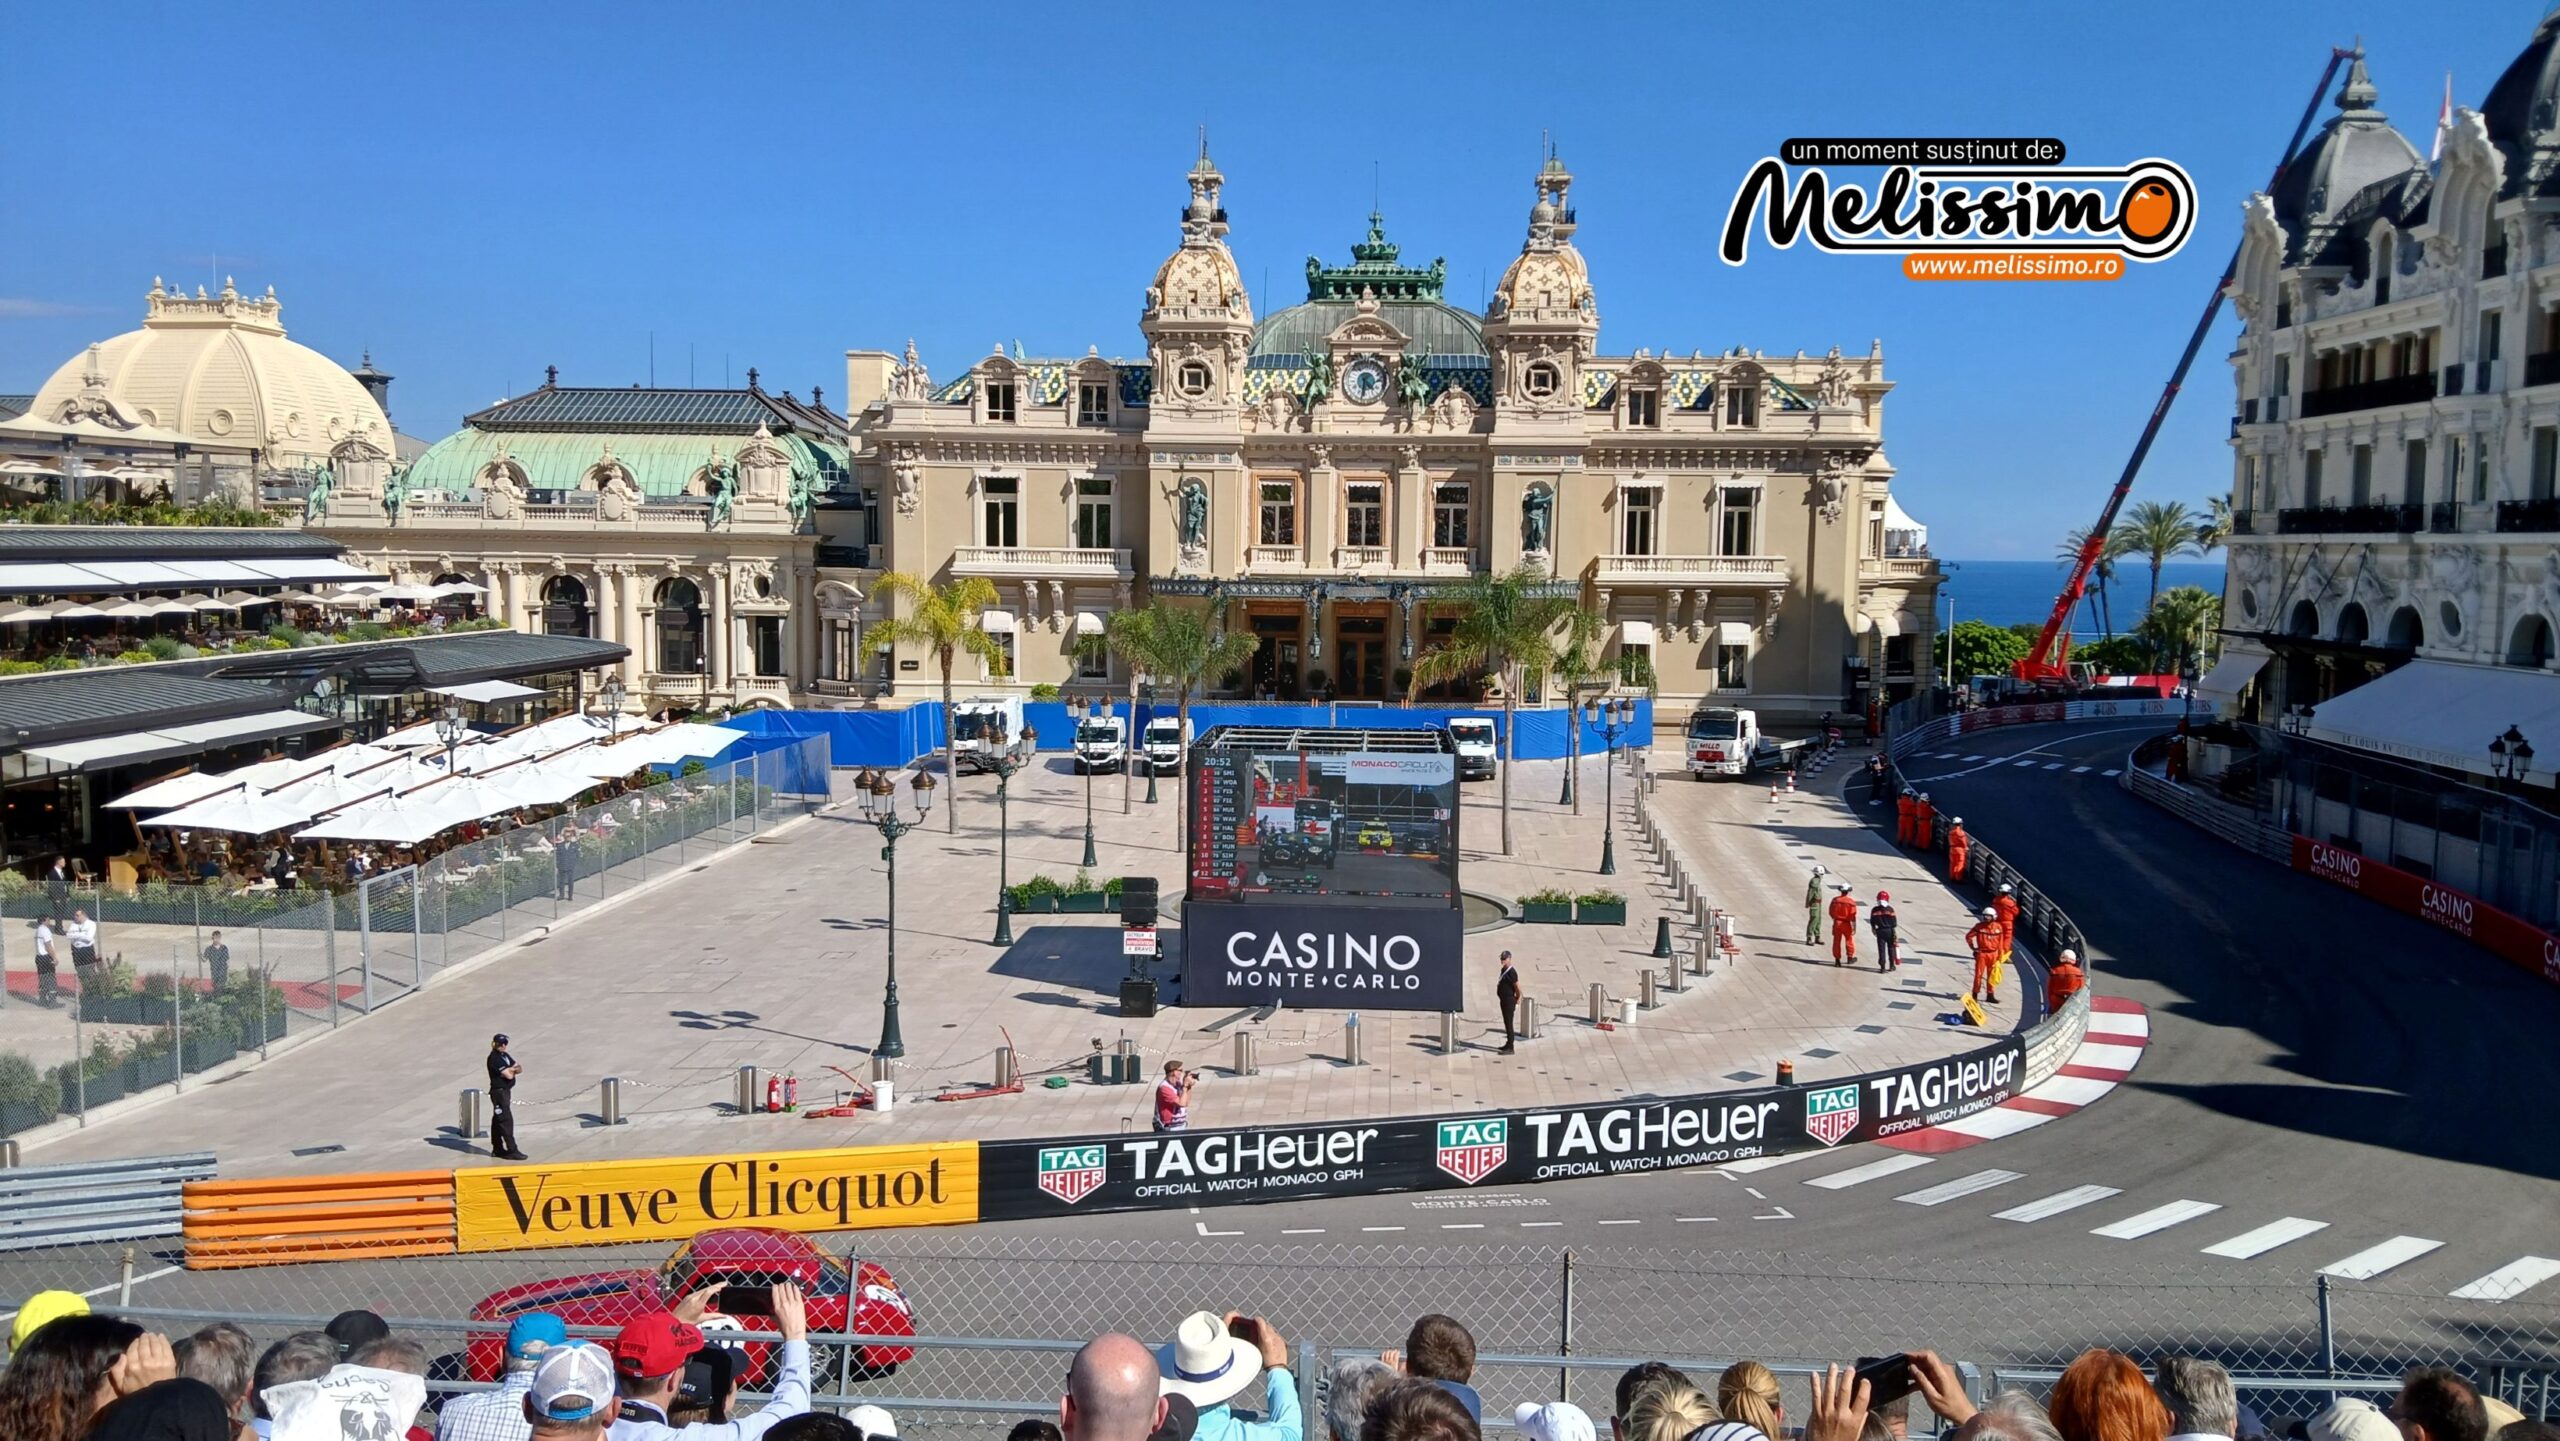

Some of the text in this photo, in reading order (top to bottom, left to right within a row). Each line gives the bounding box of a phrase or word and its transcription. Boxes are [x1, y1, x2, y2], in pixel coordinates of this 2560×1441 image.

[1204, 757, 1231, 766] 20:52
[2311, 845, 2360, 877] CASINO
[2422, 885, 2473, 924] CASINO
[1226, 930, 1421, 971] CASINO
[1226, 971, 1420, 990] MONTE CARLO
[1811, 1089, 1854, 1112] TAG
[1878, 1089, 2009, 1136] OFFICIAL WATCH MONACO GPH
[1443, 1124, 1501, 1144] TAG
[1809, 1111, 1857, 1141] HEUER
[1044, 1149, 1101, 1168] TAG
[1440, 1147, 1503, 1180] HEUER
[1537, 1146, 1762, 1179] OFFICIAL WATCH MONACO GPH
[492, 1157, 949, 1235] Veuve Clicquot
[1042, 1170, 1103, 1200] HEUER
[1135, 1168, 1364, 1197] OFFICIAL WATCH MONACO GPH
